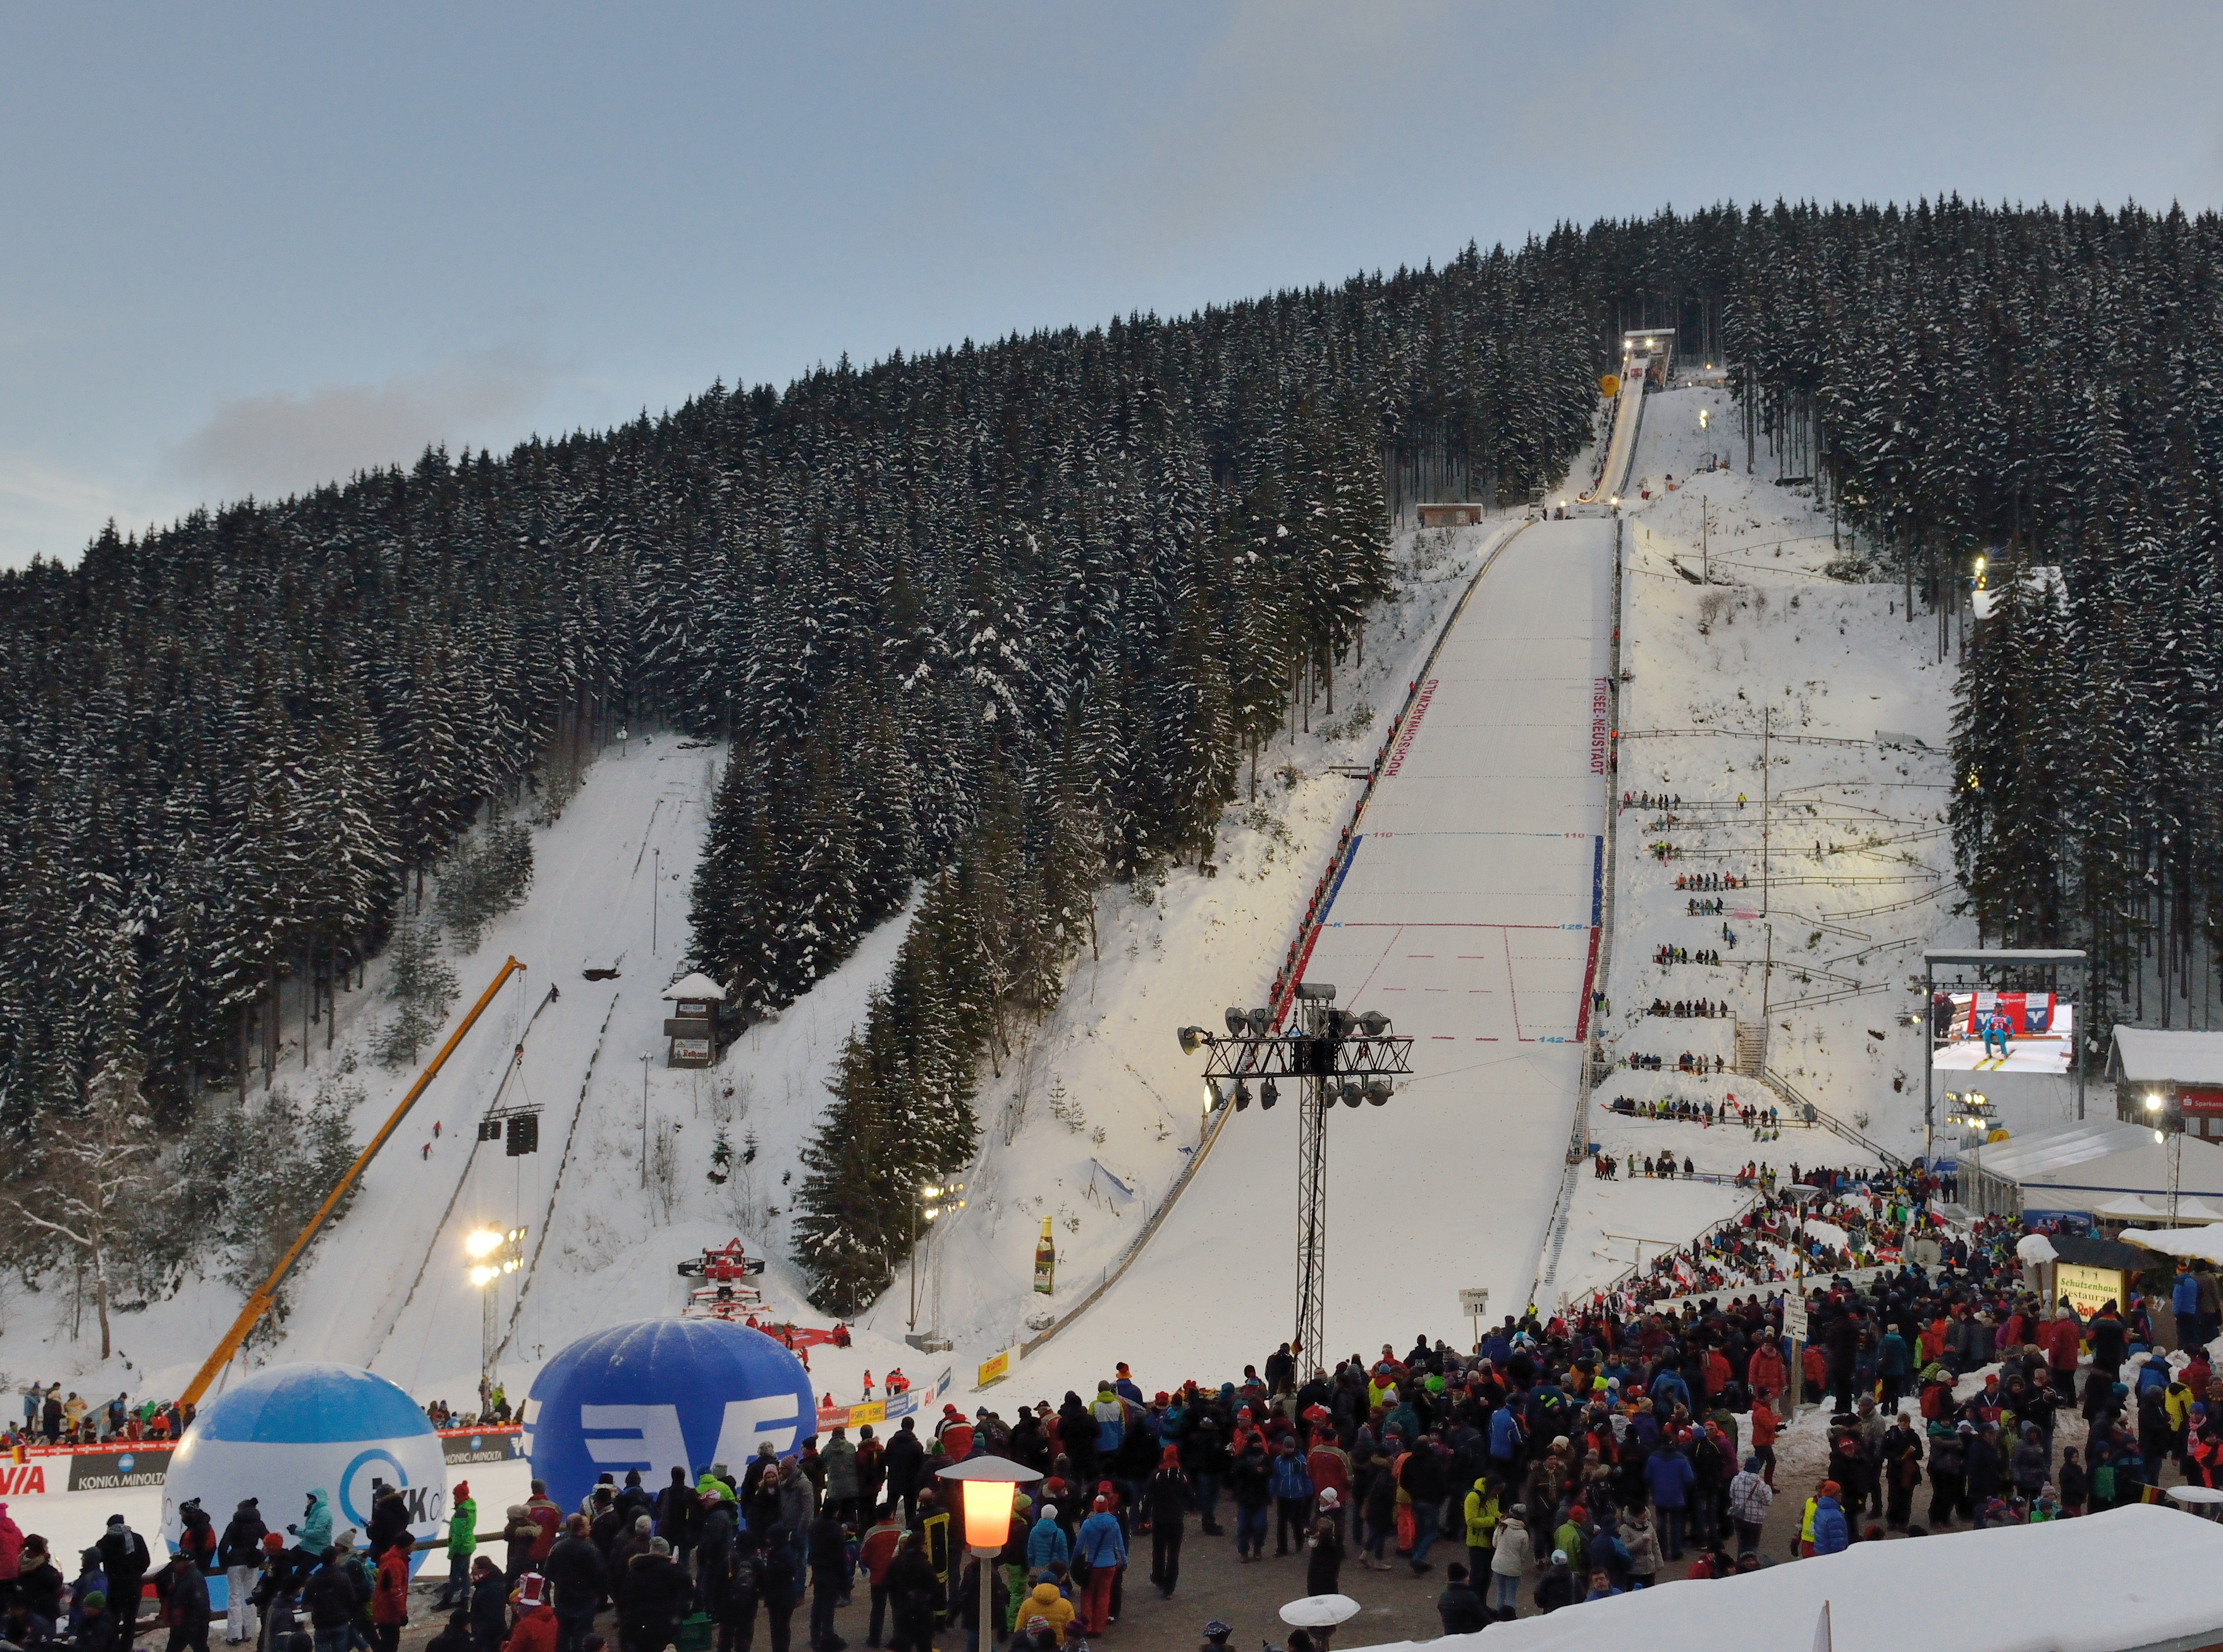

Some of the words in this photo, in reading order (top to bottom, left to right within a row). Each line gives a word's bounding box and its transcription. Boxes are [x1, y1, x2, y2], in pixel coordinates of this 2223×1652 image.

[1385, 679, 1439, 776] HOCHSCHWARZWALD
[683, 1049, 707, 1059] Rothaus
[2061, 1278, 2117, 1293] Schützenhaus
[2061, 1287, 2116, 1302] Restauran
[1474, 1304, 1483, 1312] 11
[2077, 1302, 2097, 1318] Roth
[1785, 1324, 1796, 1336] WC
[990, 1359, 1001, 1371] LOTTO
[472, 1451, 502, 1462] MINOLTA
[78, 1475, 119, 1490] KONICA
